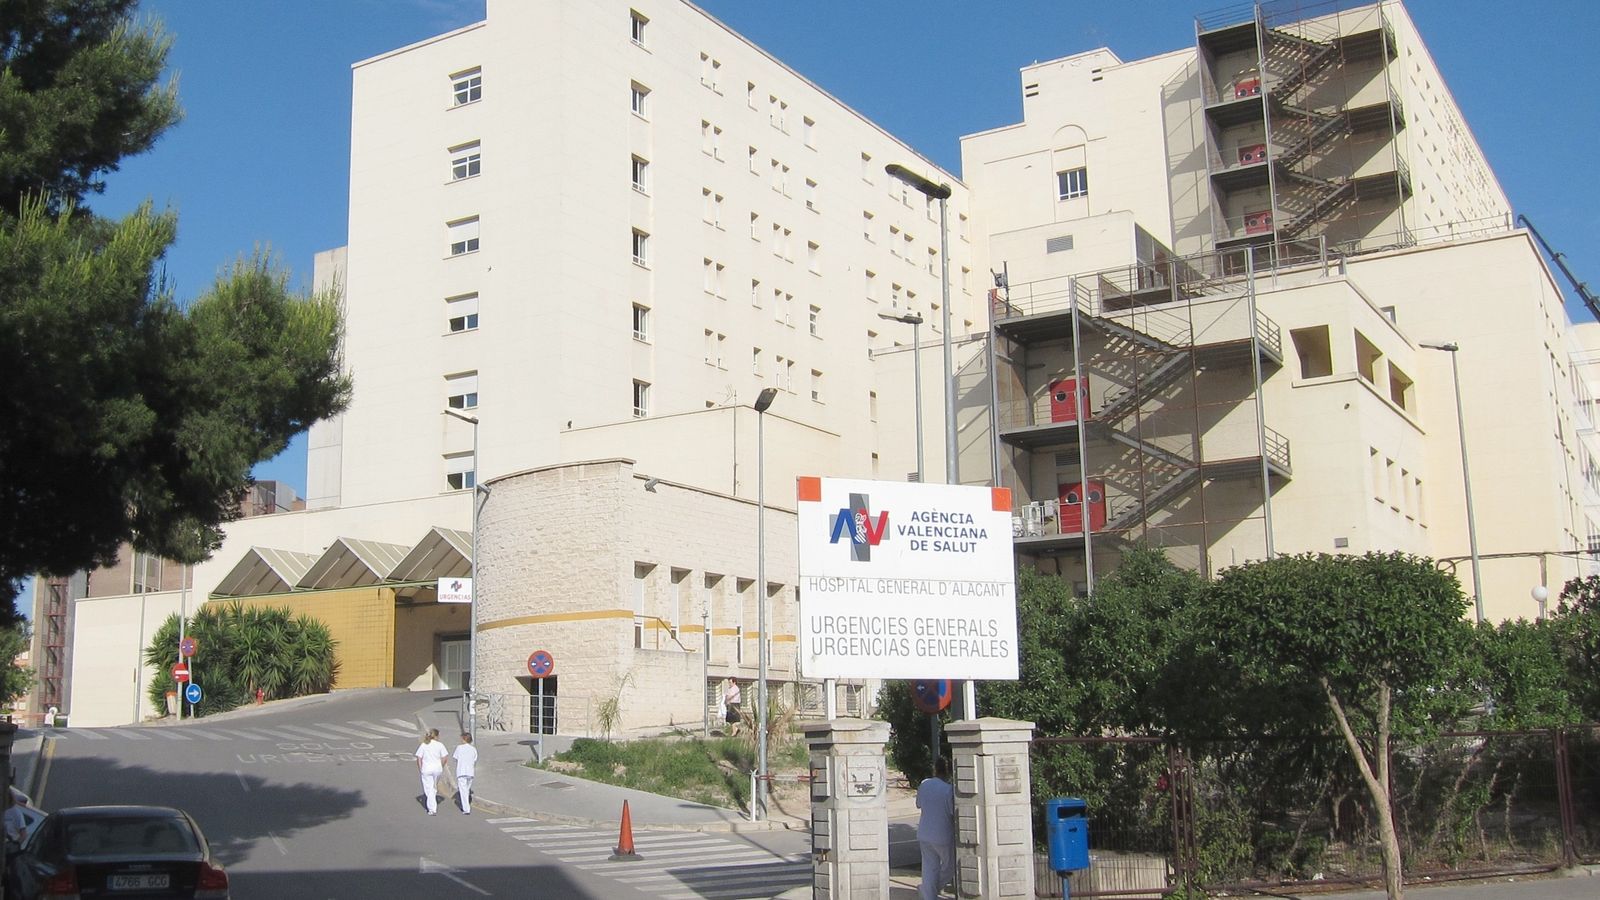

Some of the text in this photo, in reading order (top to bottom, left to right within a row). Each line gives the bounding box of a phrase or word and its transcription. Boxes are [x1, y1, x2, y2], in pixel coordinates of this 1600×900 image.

[911, 508, 974, 524] AGÈNCIA
[897, 525, 988, 539] VALENCIANA
[910, 540, 977, 553] DE SALUT
[809, 577, 873, 593] HOSPITAL
[877, 579, 935, 595] GENERAL
[811, 616, 998, 637] URGENCIES GENERALS
[812, 637, 1009, 658] URGENCIAS GENERALES
